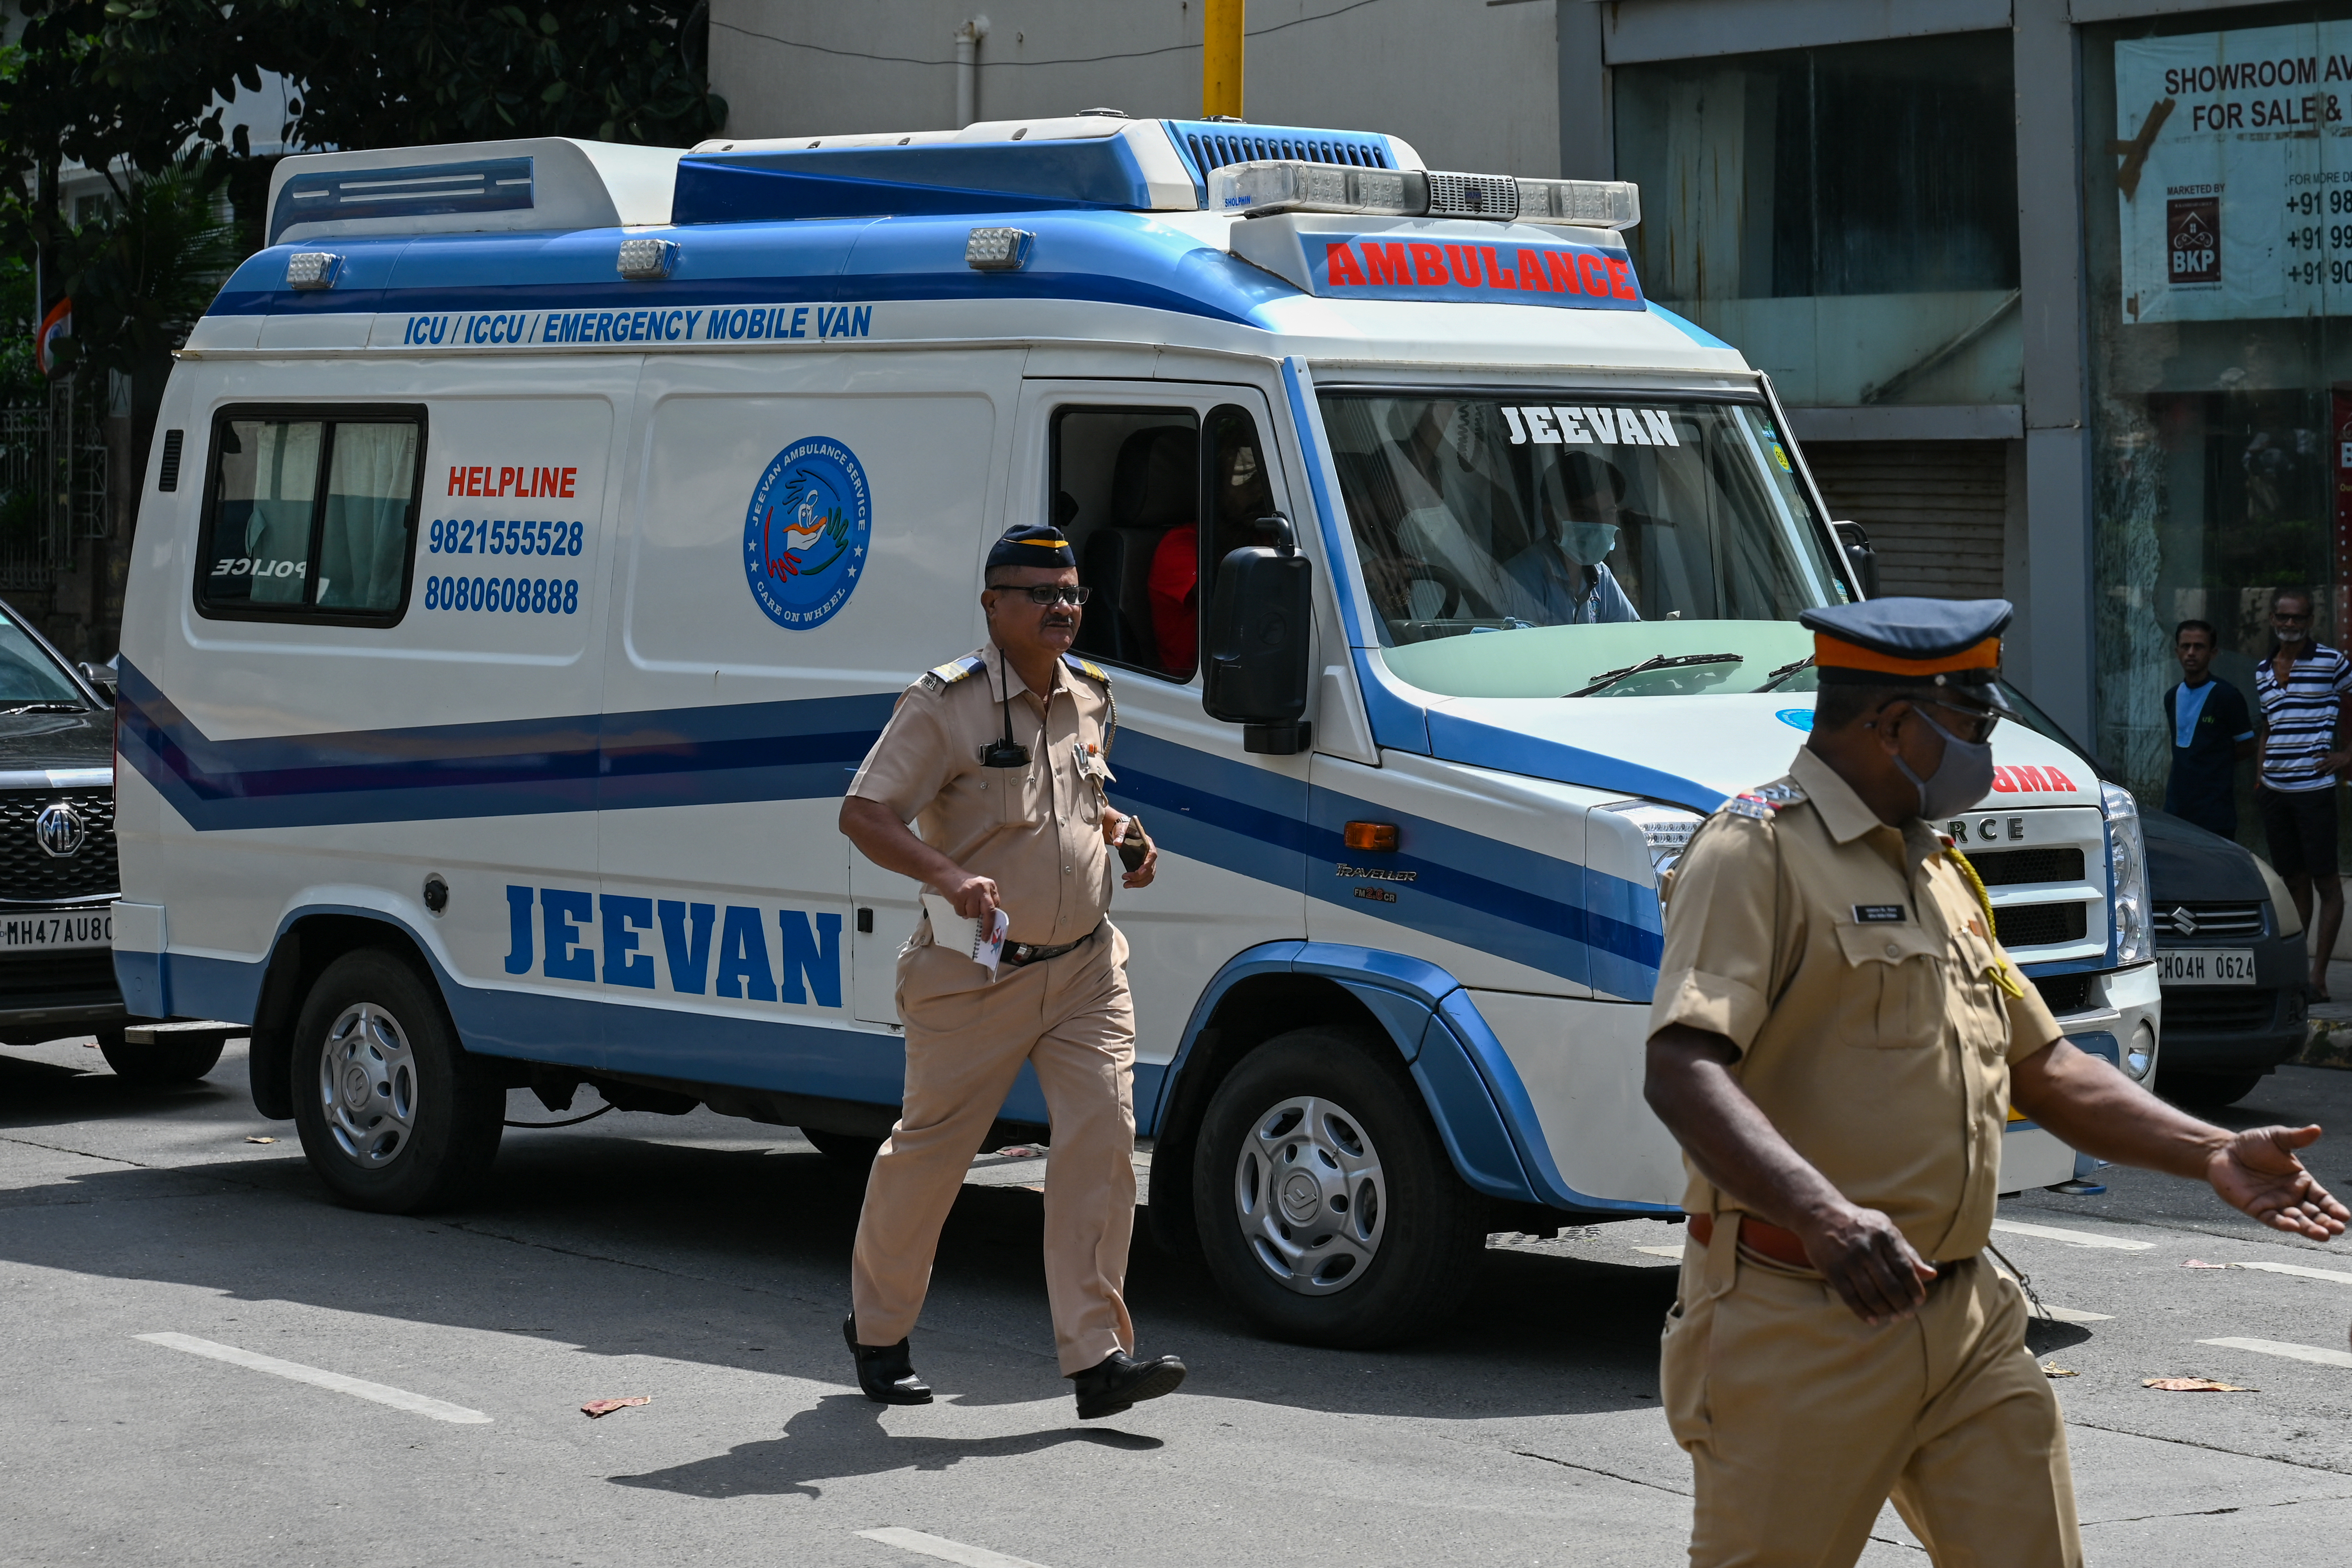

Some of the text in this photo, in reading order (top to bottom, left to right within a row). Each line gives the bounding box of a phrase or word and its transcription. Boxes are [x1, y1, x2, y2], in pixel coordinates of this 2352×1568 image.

[2164, 58, 2316, 95] SHOWROOM
[2193, 94, 2342, 131] FOR SALE &
[2167, 183, 2226, 195] MARKETED BY
[2289, 174, 2311, 186] FOR
[2313, 172, 2340, 185] MORE
[1225, 195, 1251, 207] SHOLPHIN
[2286, 191, 2322, 215] +91
[2287, 226, 2322, 250] +91
[1326, 242, 1636, 301] AMBULANCE
[2173, 249, 2215, 272] BKP
[2288, 261, 2322, 284] +91
[403, 316, 448, 345] ICU
[464, 314, 526, 344] ICCU
[542, 310, 704, 343] EMERGENCY
[707, 307, 809, 340] MOBILE
[817, 305, 873, 338] VAN
[1500, 406, 1680, 447] JEEVAN
[447, 466, 578, 498] HELPLINE
[752, 444, 866, 531] JEEVAN AMBULANCE SERVICE
[429, 519, 584, 556] 9821555528
[425, 576, 579, 615] 8080608888
[757, 581, 846, 623] CARE ON WHEEL
[42, 809, 80, 851] MG
[1927, 816, 2025, 843] RCE
[1335, 863, 1417, 881] TRAVELLER
[504, 884, 843, 1009] JEEVAN
[2216, 956, 2253, 978] 0624
